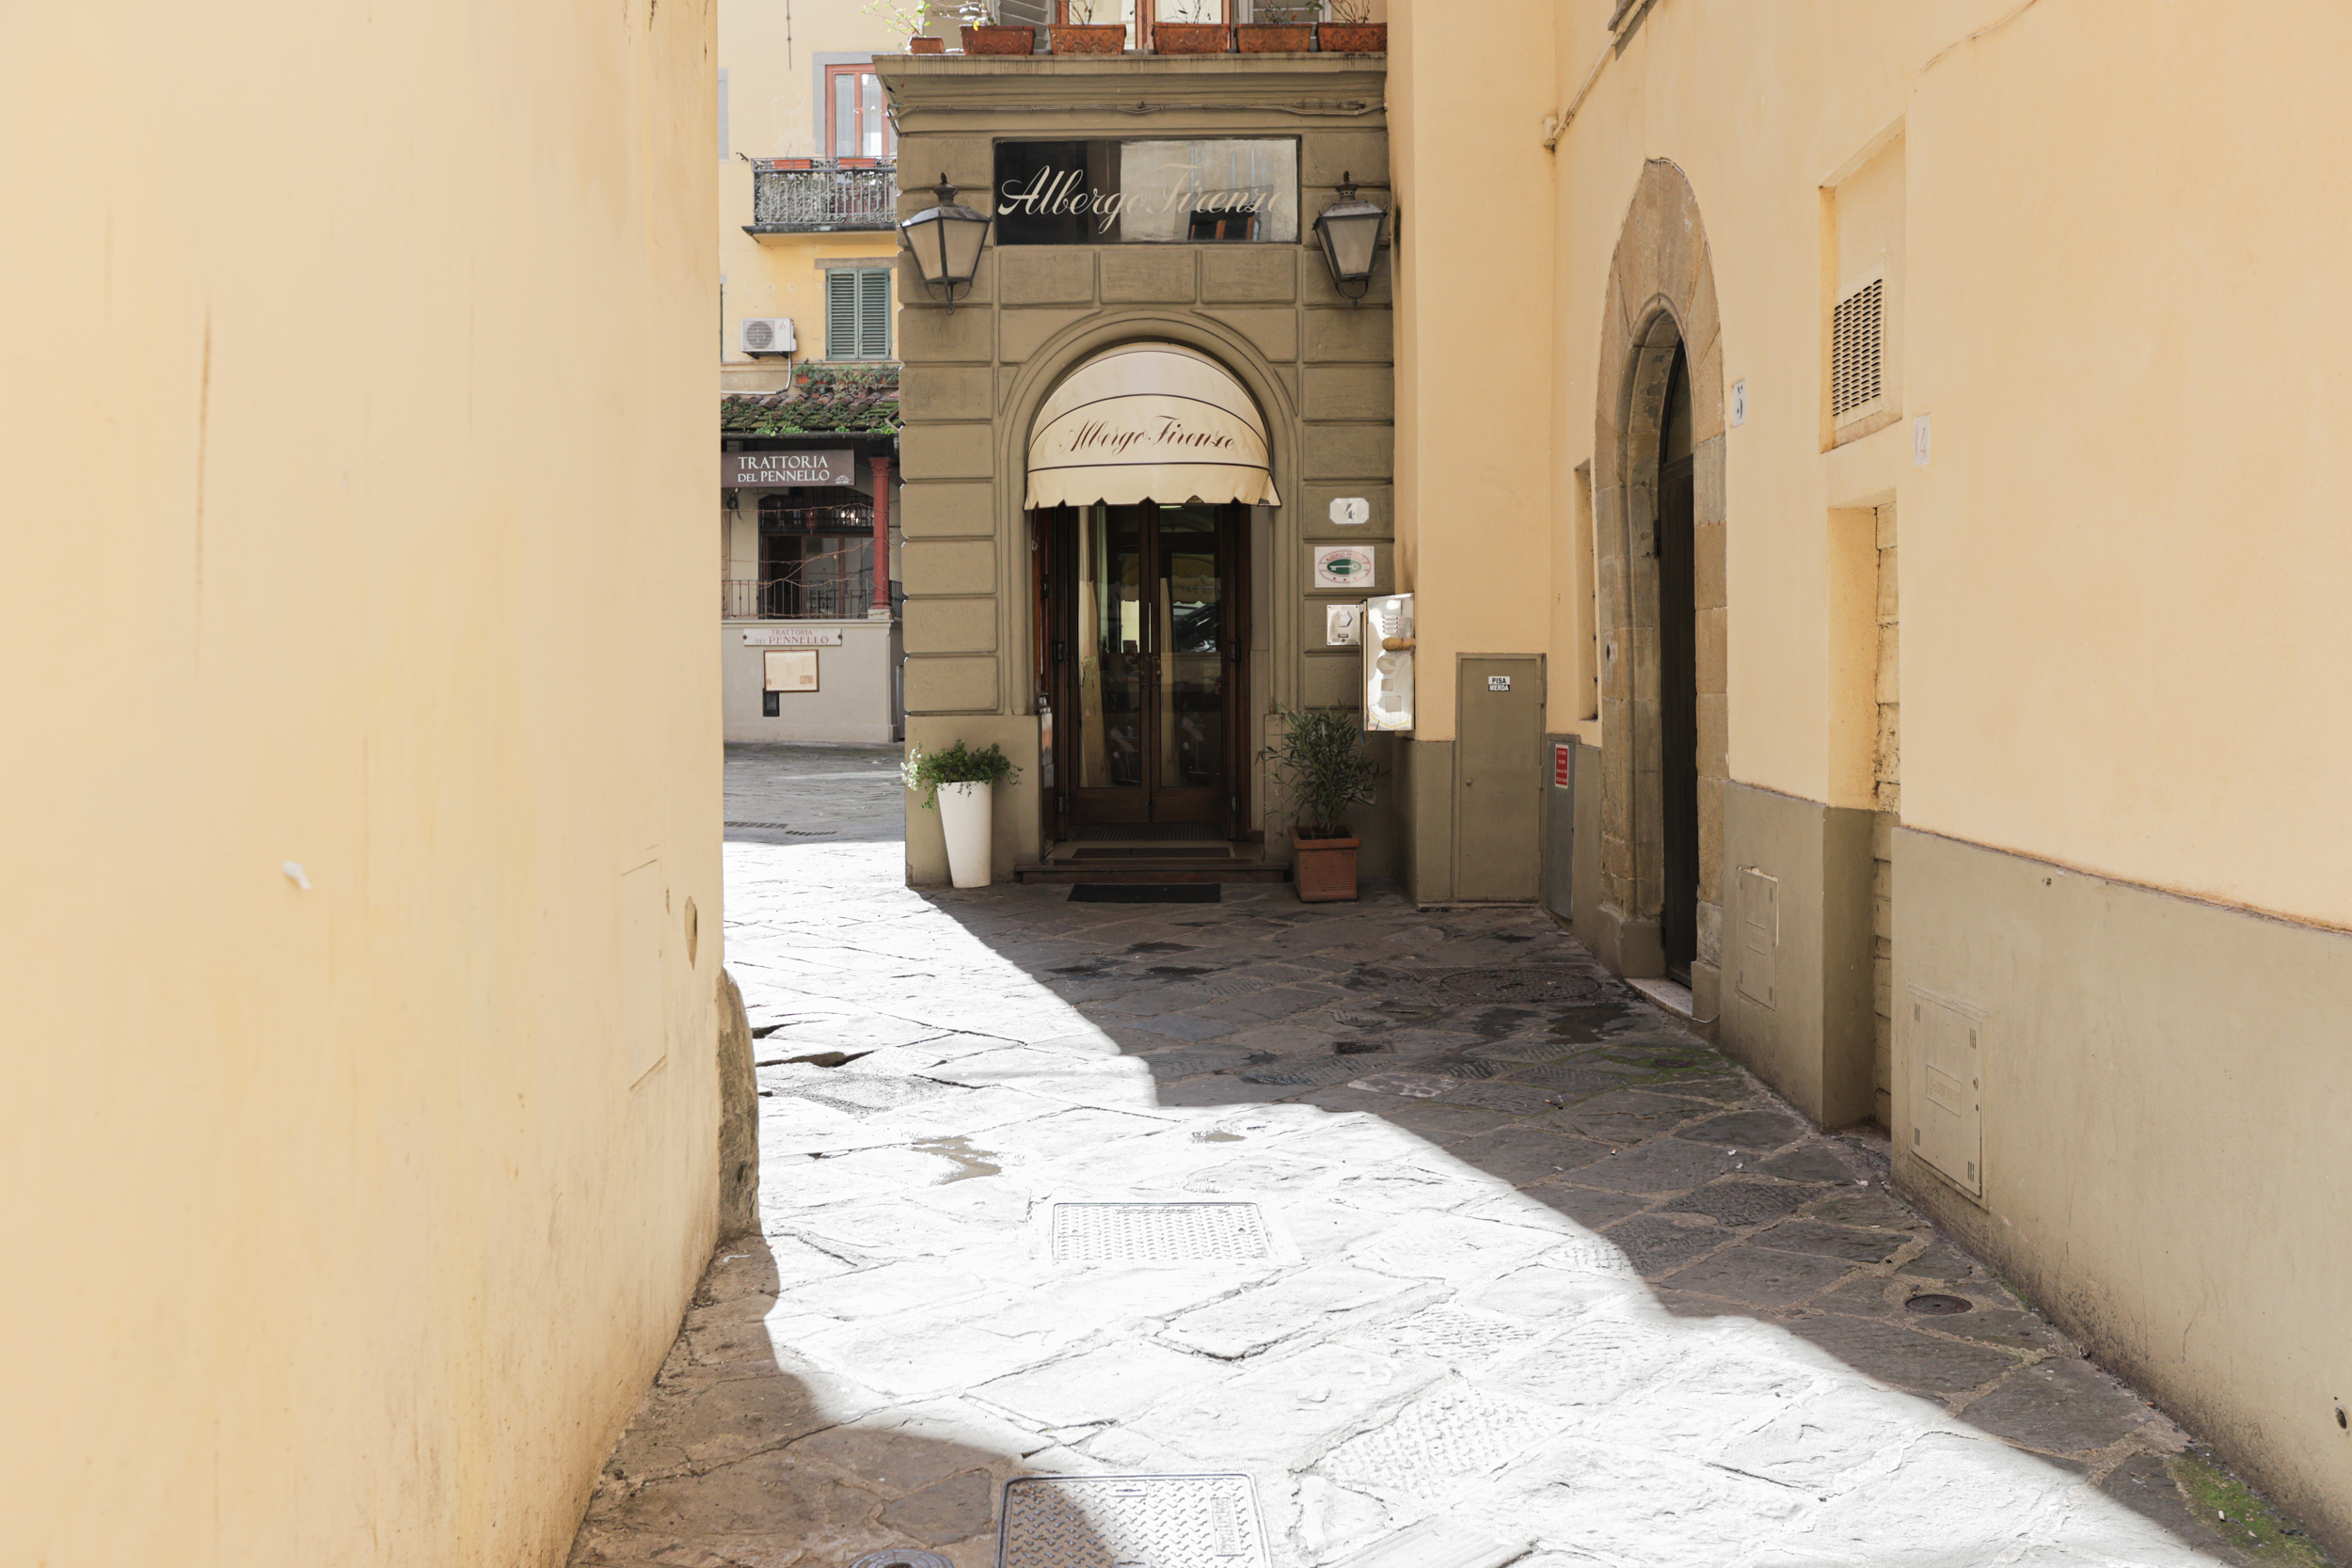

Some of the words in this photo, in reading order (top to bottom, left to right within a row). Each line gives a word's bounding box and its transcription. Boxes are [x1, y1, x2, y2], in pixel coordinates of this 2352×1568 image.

[997, 165, 1147, 234] Albergo
[1736, 384, 1744, 420] 5
[1057, 418, 1148, 456] Albergo
[1148, 415, 1236, 450] Firenze
[738, 455, 829, 469] TRATTORIA
[738, 473, 758, 483] DEL
[760, 469, 831, 483] PENNELLO
[1343, 502, 1356, 520] 4
[769, 636, 830, 644] PENNELLO
